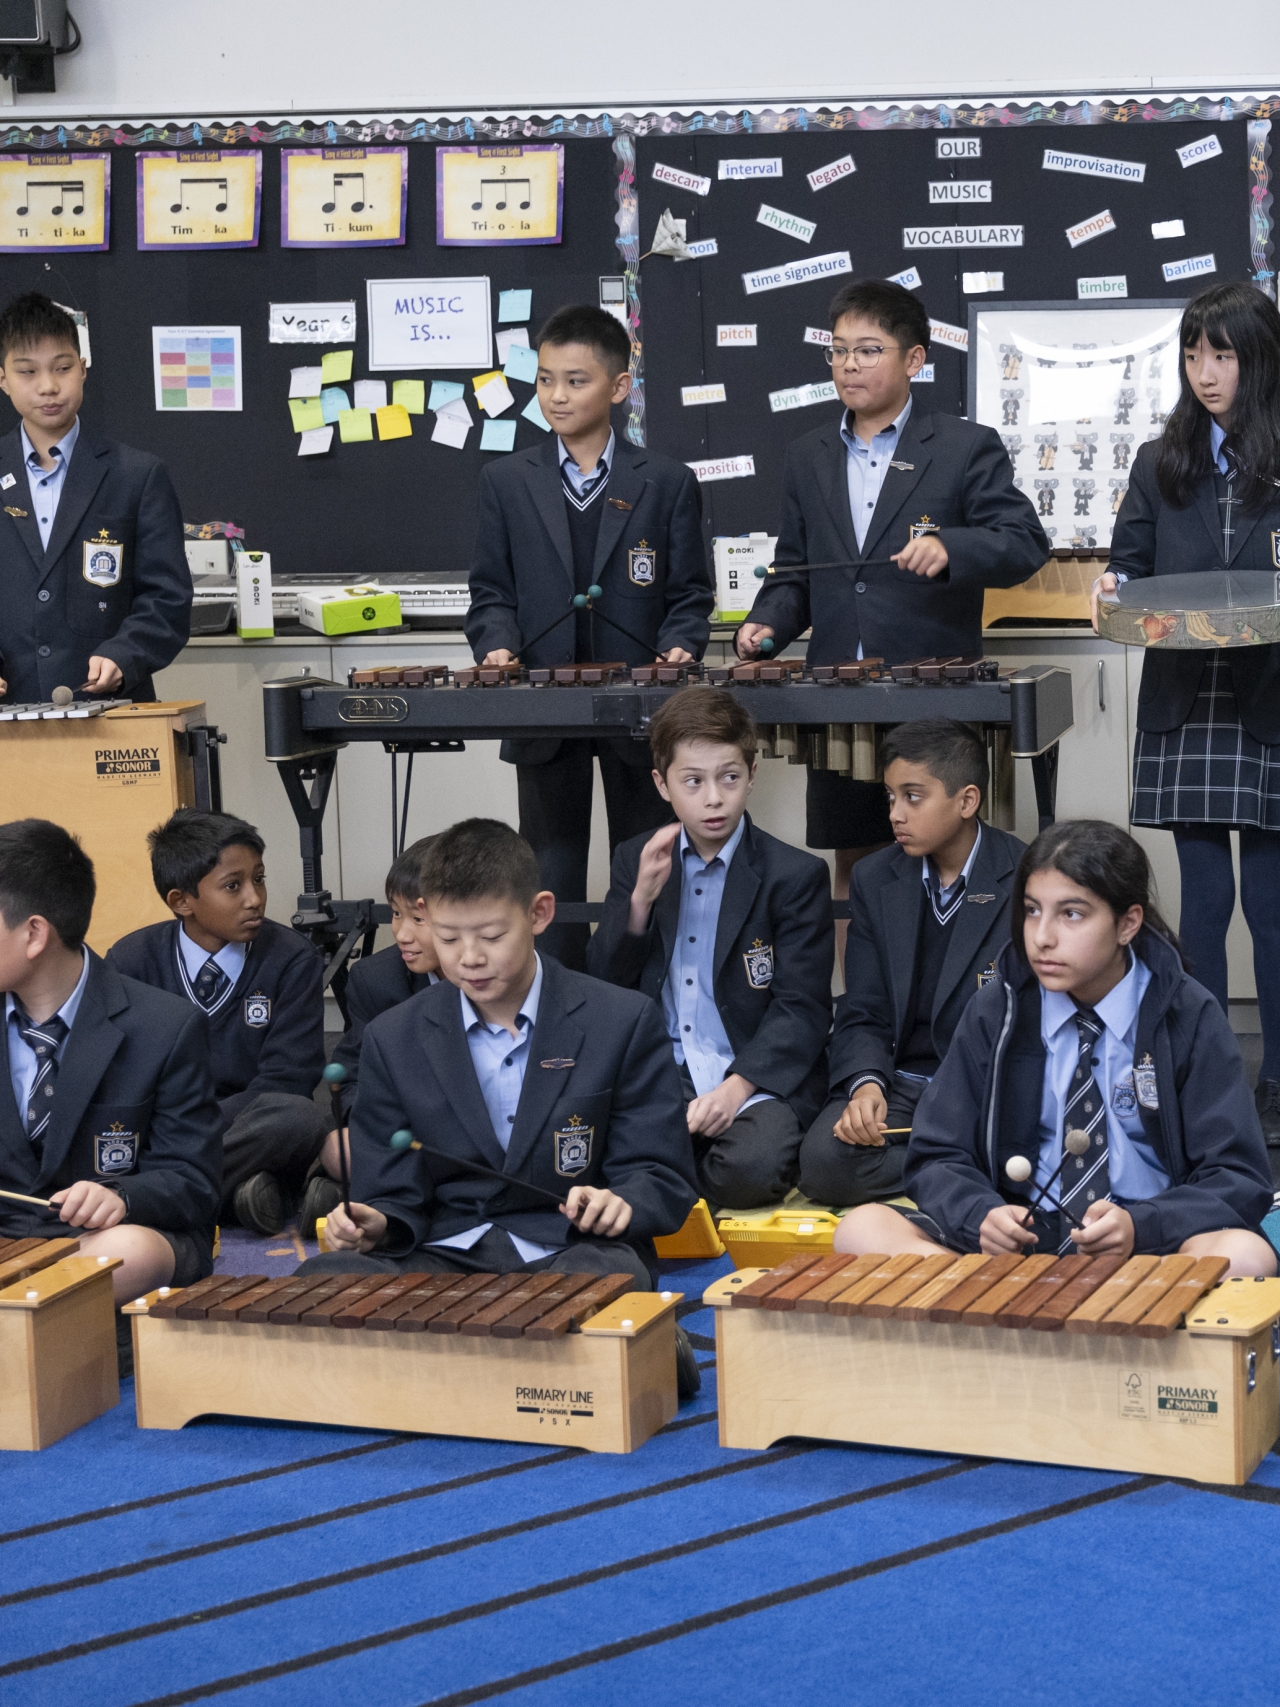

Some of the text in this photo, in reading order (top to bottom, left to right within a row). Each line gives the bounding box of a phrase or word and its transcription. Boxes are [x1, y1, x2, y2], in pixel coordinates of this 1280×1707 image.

[940, 141, 977, 156] OUR
[1181, 139, 1217, 160] score
[726, 161, 778, 176] interval
[1047, 152, 1140, 178] improvisation
[810, 161, 852, 186] legato
[932, 184, 988, 200] MUSIC
[171, 225, 227, 235] Tim ka
[324, 222, 373, 232] Ti kum
[472, 221, 487, 231] Tri
[521, 221, 530, 230] la
[764, 210, 811, 237] rhythm
[1070, 213, 1113, 240] tempo
[17, 228, 28, 238] Ti
[906, 228, 1020, 245] VOCABULARY
[689, 241, 715, 254] non
[751, 258, 847, 288] time signature
[1165, 257, 1212, 277] barline
[1079, 280, 1125, 293] timbre
[394, 297, 464, 315] MUSIC
[282, 315, 351, 333] Year 6
[410, 325, 451, 341] IS...
[720, 327, 753, 342] pitch
[684, 388, 724, 402] metre
[692, 461, 752, 478] position
[95, 748, 159, 761] PRIMARY
[115, 761, 152, 773] SONOR
[516, 1387, 594, 1404] PRIMARY LINE
[1158, 1385, 1218, 1400] PRIMARY
[1175, 1401, 1209, 1412] SONOR
